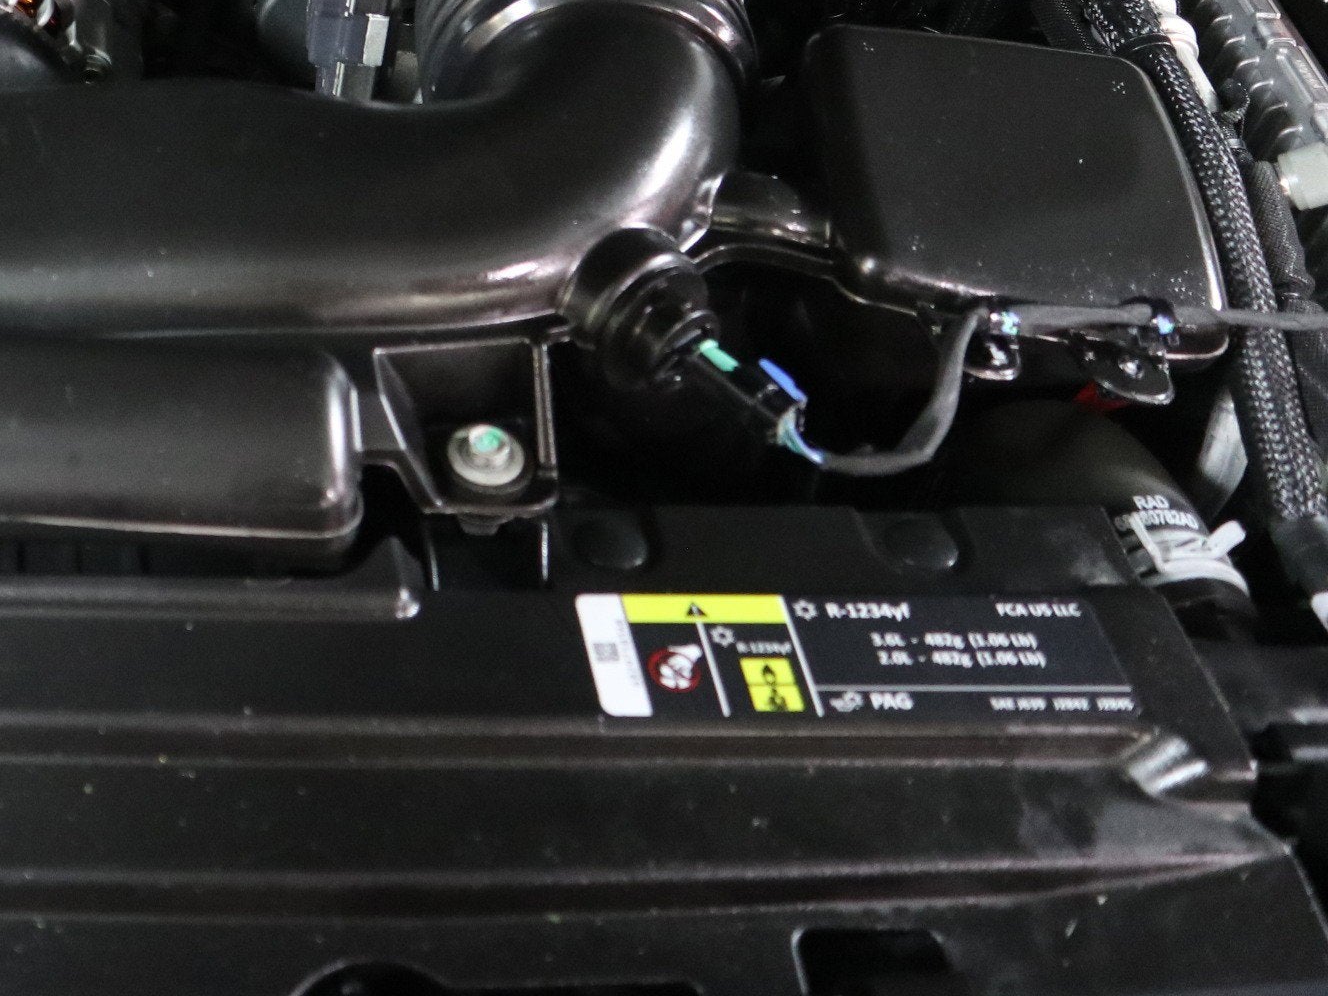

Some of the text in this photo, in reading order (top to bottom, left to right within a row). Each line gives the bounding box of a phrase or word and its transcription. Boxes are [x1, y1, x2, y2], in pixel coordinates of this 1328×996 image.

[1132, 494, 1170, 511] RAD
[824, 601, 911, 623] R-1234yf
[995, 602, 1082, 617] FCA US LLC
[869, 691, 914, 711] PAG
